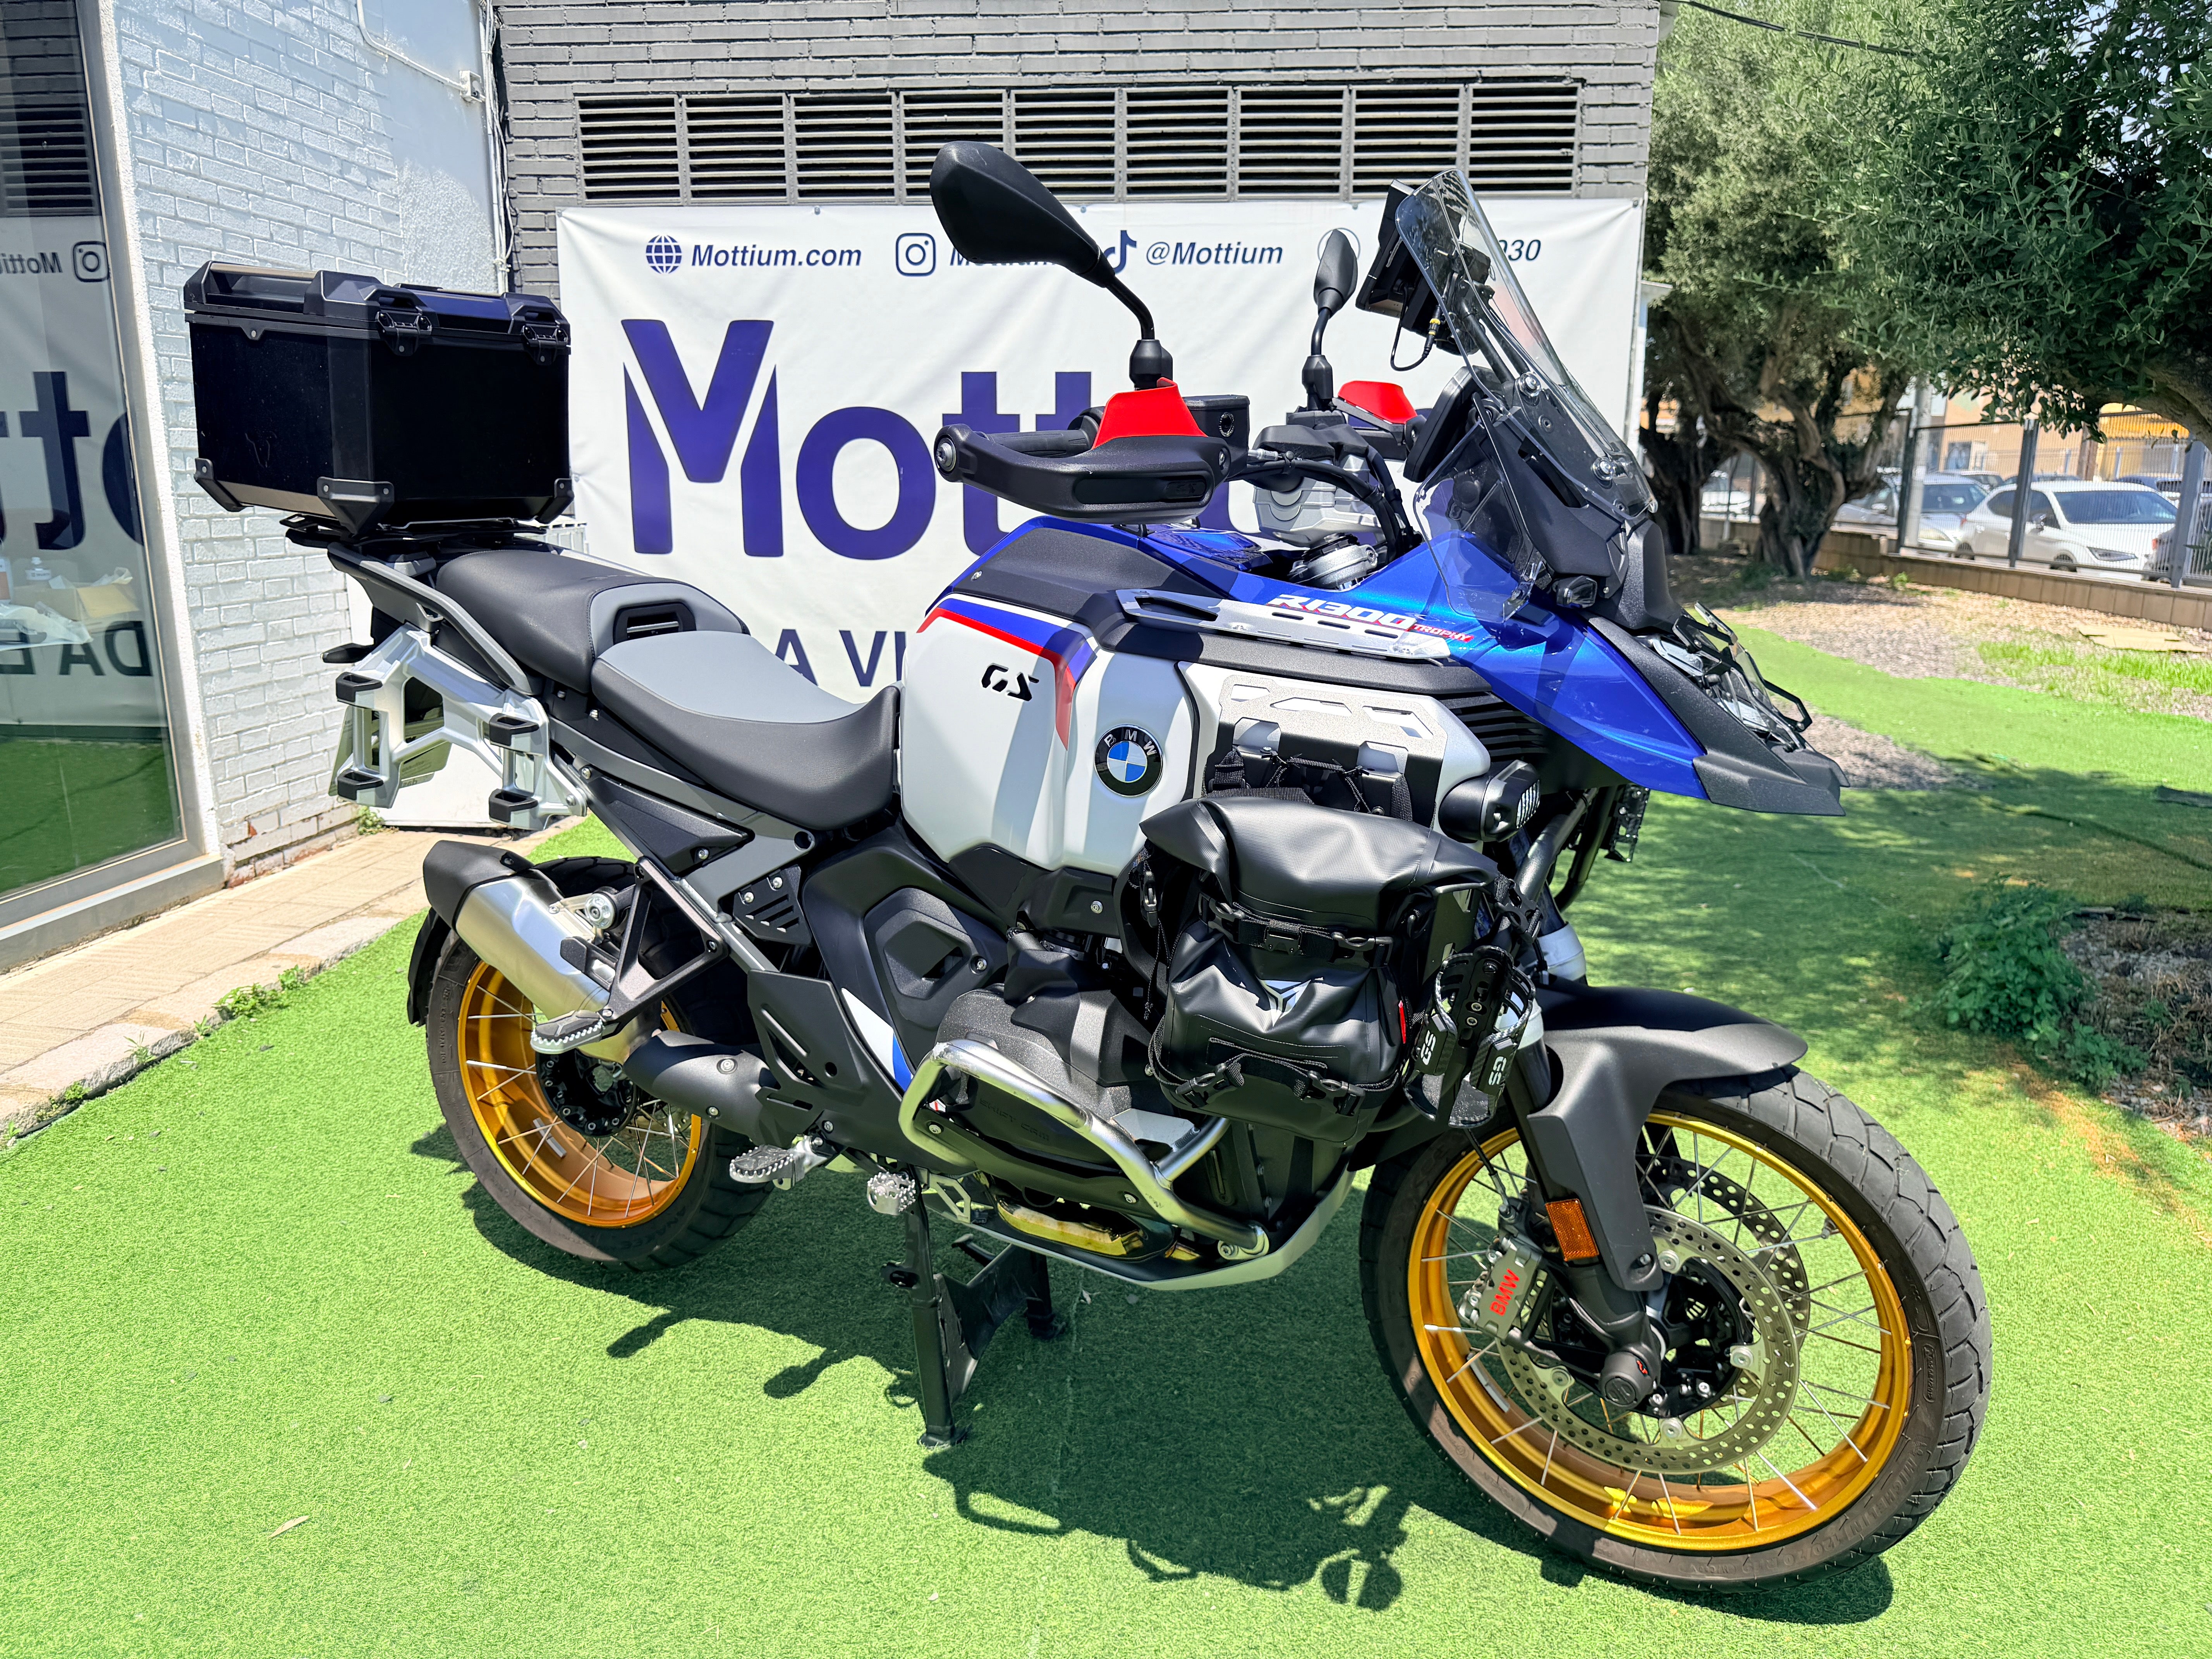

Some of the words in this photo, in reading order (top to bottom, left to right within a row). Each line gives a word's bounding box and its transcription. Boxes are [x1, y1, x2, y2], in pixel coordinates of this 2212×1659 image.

[691, 244, 862, 267] Mottium.com
[1146, 241, 1283, 265] @Mottium
[1413, 623, 1471, 641] TROPHY
[981, 664, 1039, 701] GS
[1104, 729, 1158, 756] BMW
[1420, 1030, 1436, 1065] GS
[1488, 1056, 1507, 1085] GS
[1489, 1268, 1520, 1316] BMW
